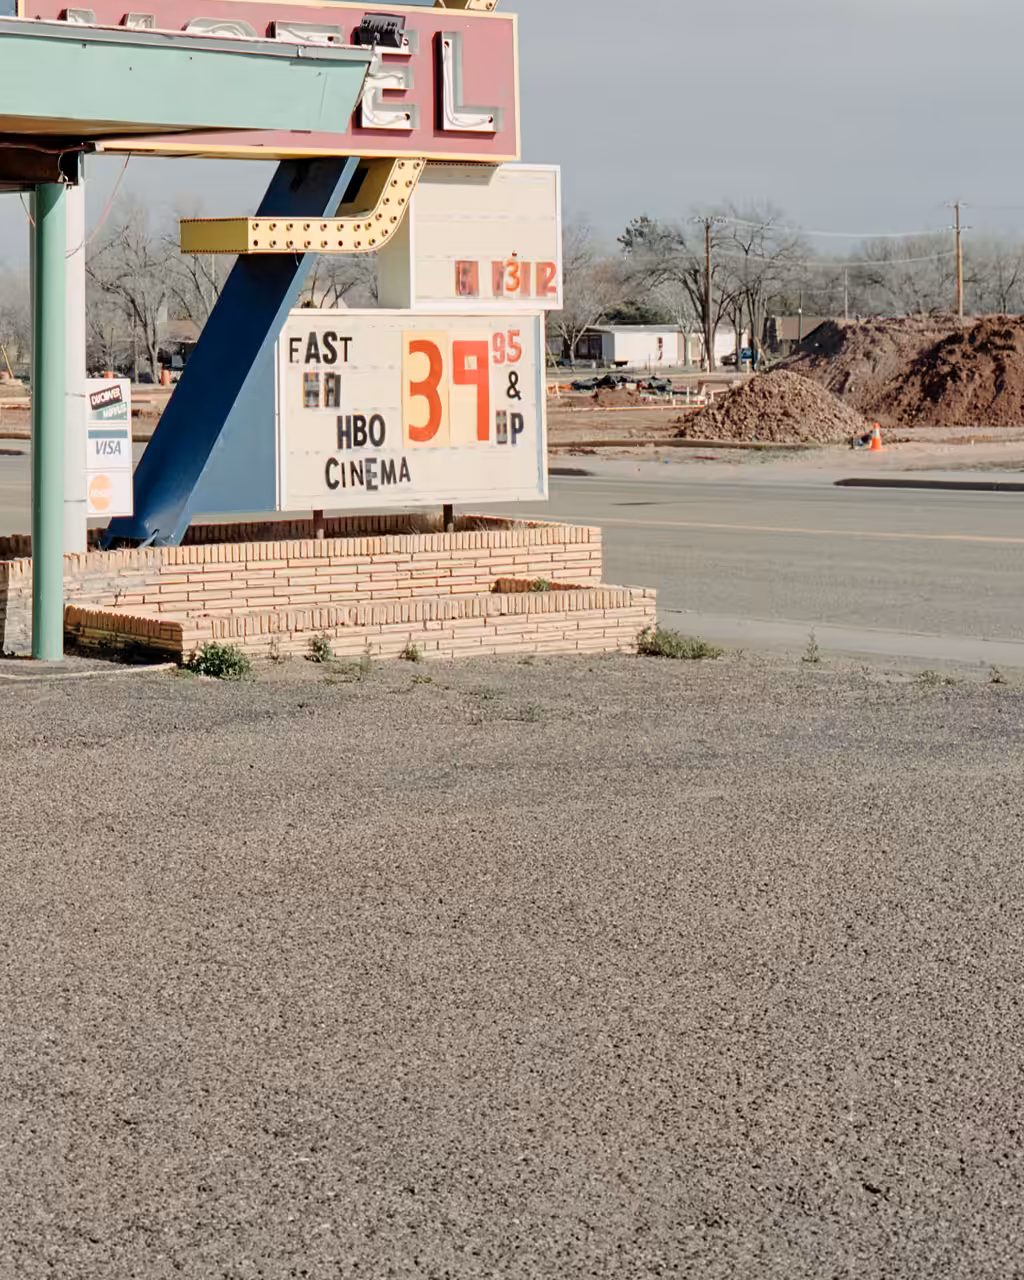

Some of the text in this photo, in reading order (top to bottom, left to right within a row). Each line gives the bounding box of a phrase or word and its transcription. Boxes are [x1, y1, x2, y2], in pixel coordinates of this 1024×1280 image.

[408, 339, 490, 442] 39
[491, 329, 523, 364] 95
[506, 371, 522, 401] &
[95, 440, 122, 456] VISA
[336, 414, 386, 449] HBO
[325, 456, 411, 491] CINEMA
